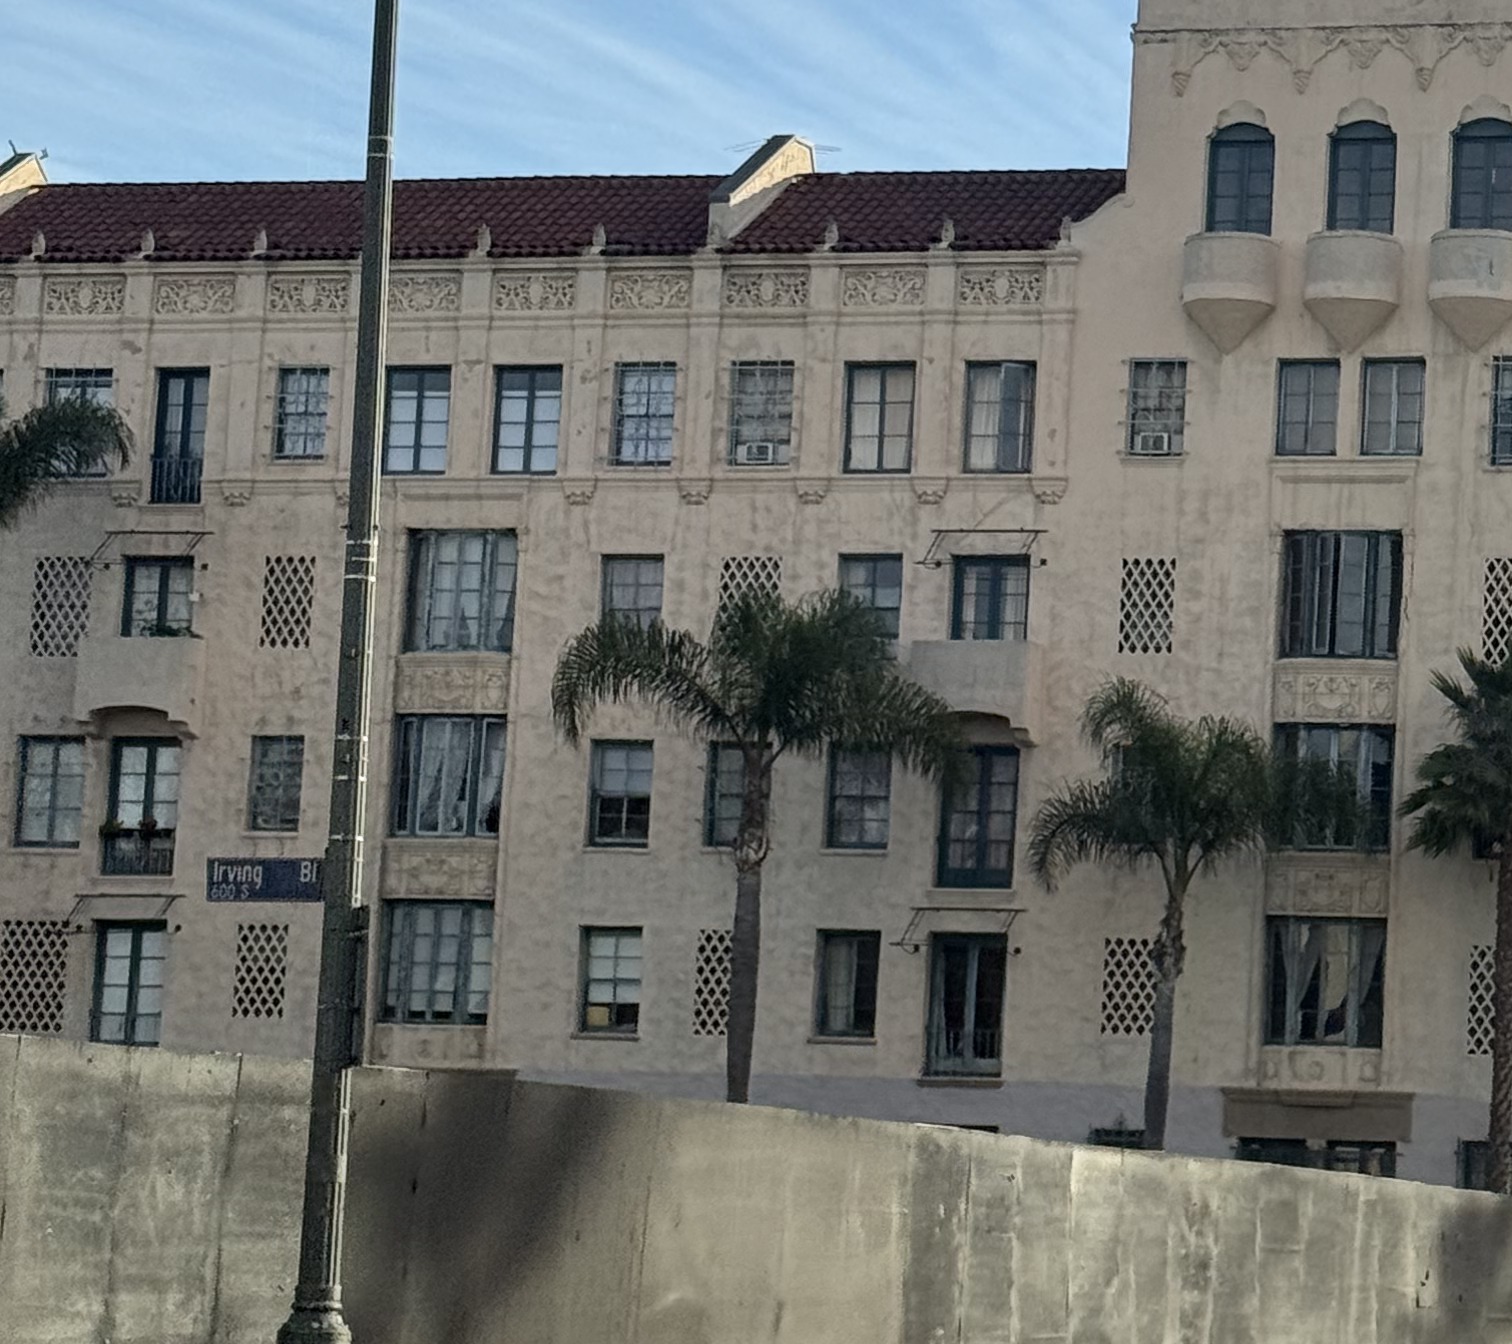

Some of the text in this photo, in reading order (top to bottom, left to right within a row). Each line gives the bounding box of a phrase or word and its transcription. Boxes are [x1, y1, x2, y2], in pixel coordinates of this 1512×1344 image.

[213, 860, 263, 890] Irving
[210, 883, 250, 900] 600 S
